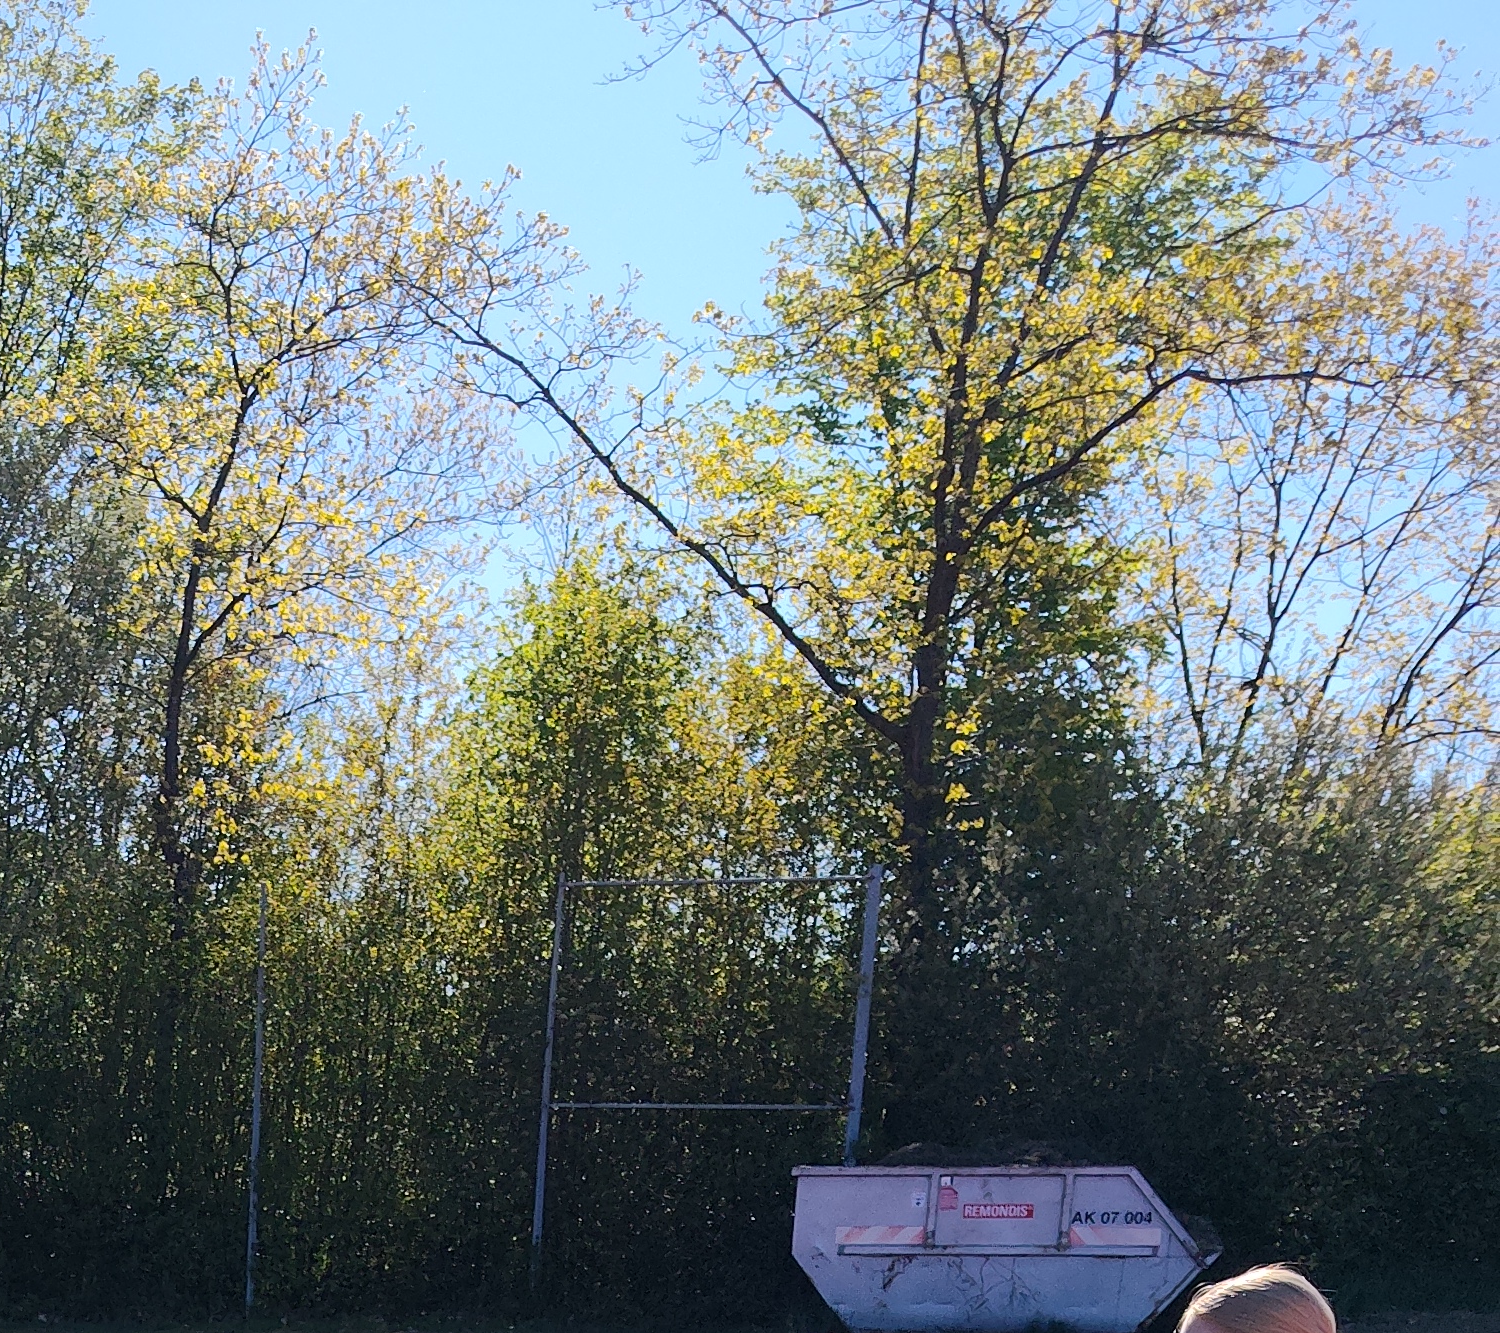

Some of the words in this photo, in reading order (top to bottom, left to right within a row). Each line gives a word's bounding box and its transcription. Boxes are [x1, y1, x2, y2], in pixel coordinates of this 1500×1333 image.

[964, 1205, 1028, 1217] REMONDIS
[1071, 1211, 1096, 1225] AK
[1101, 1211, 1120, 1225] 07
[1124, 1211, 1152, 1225] 004
